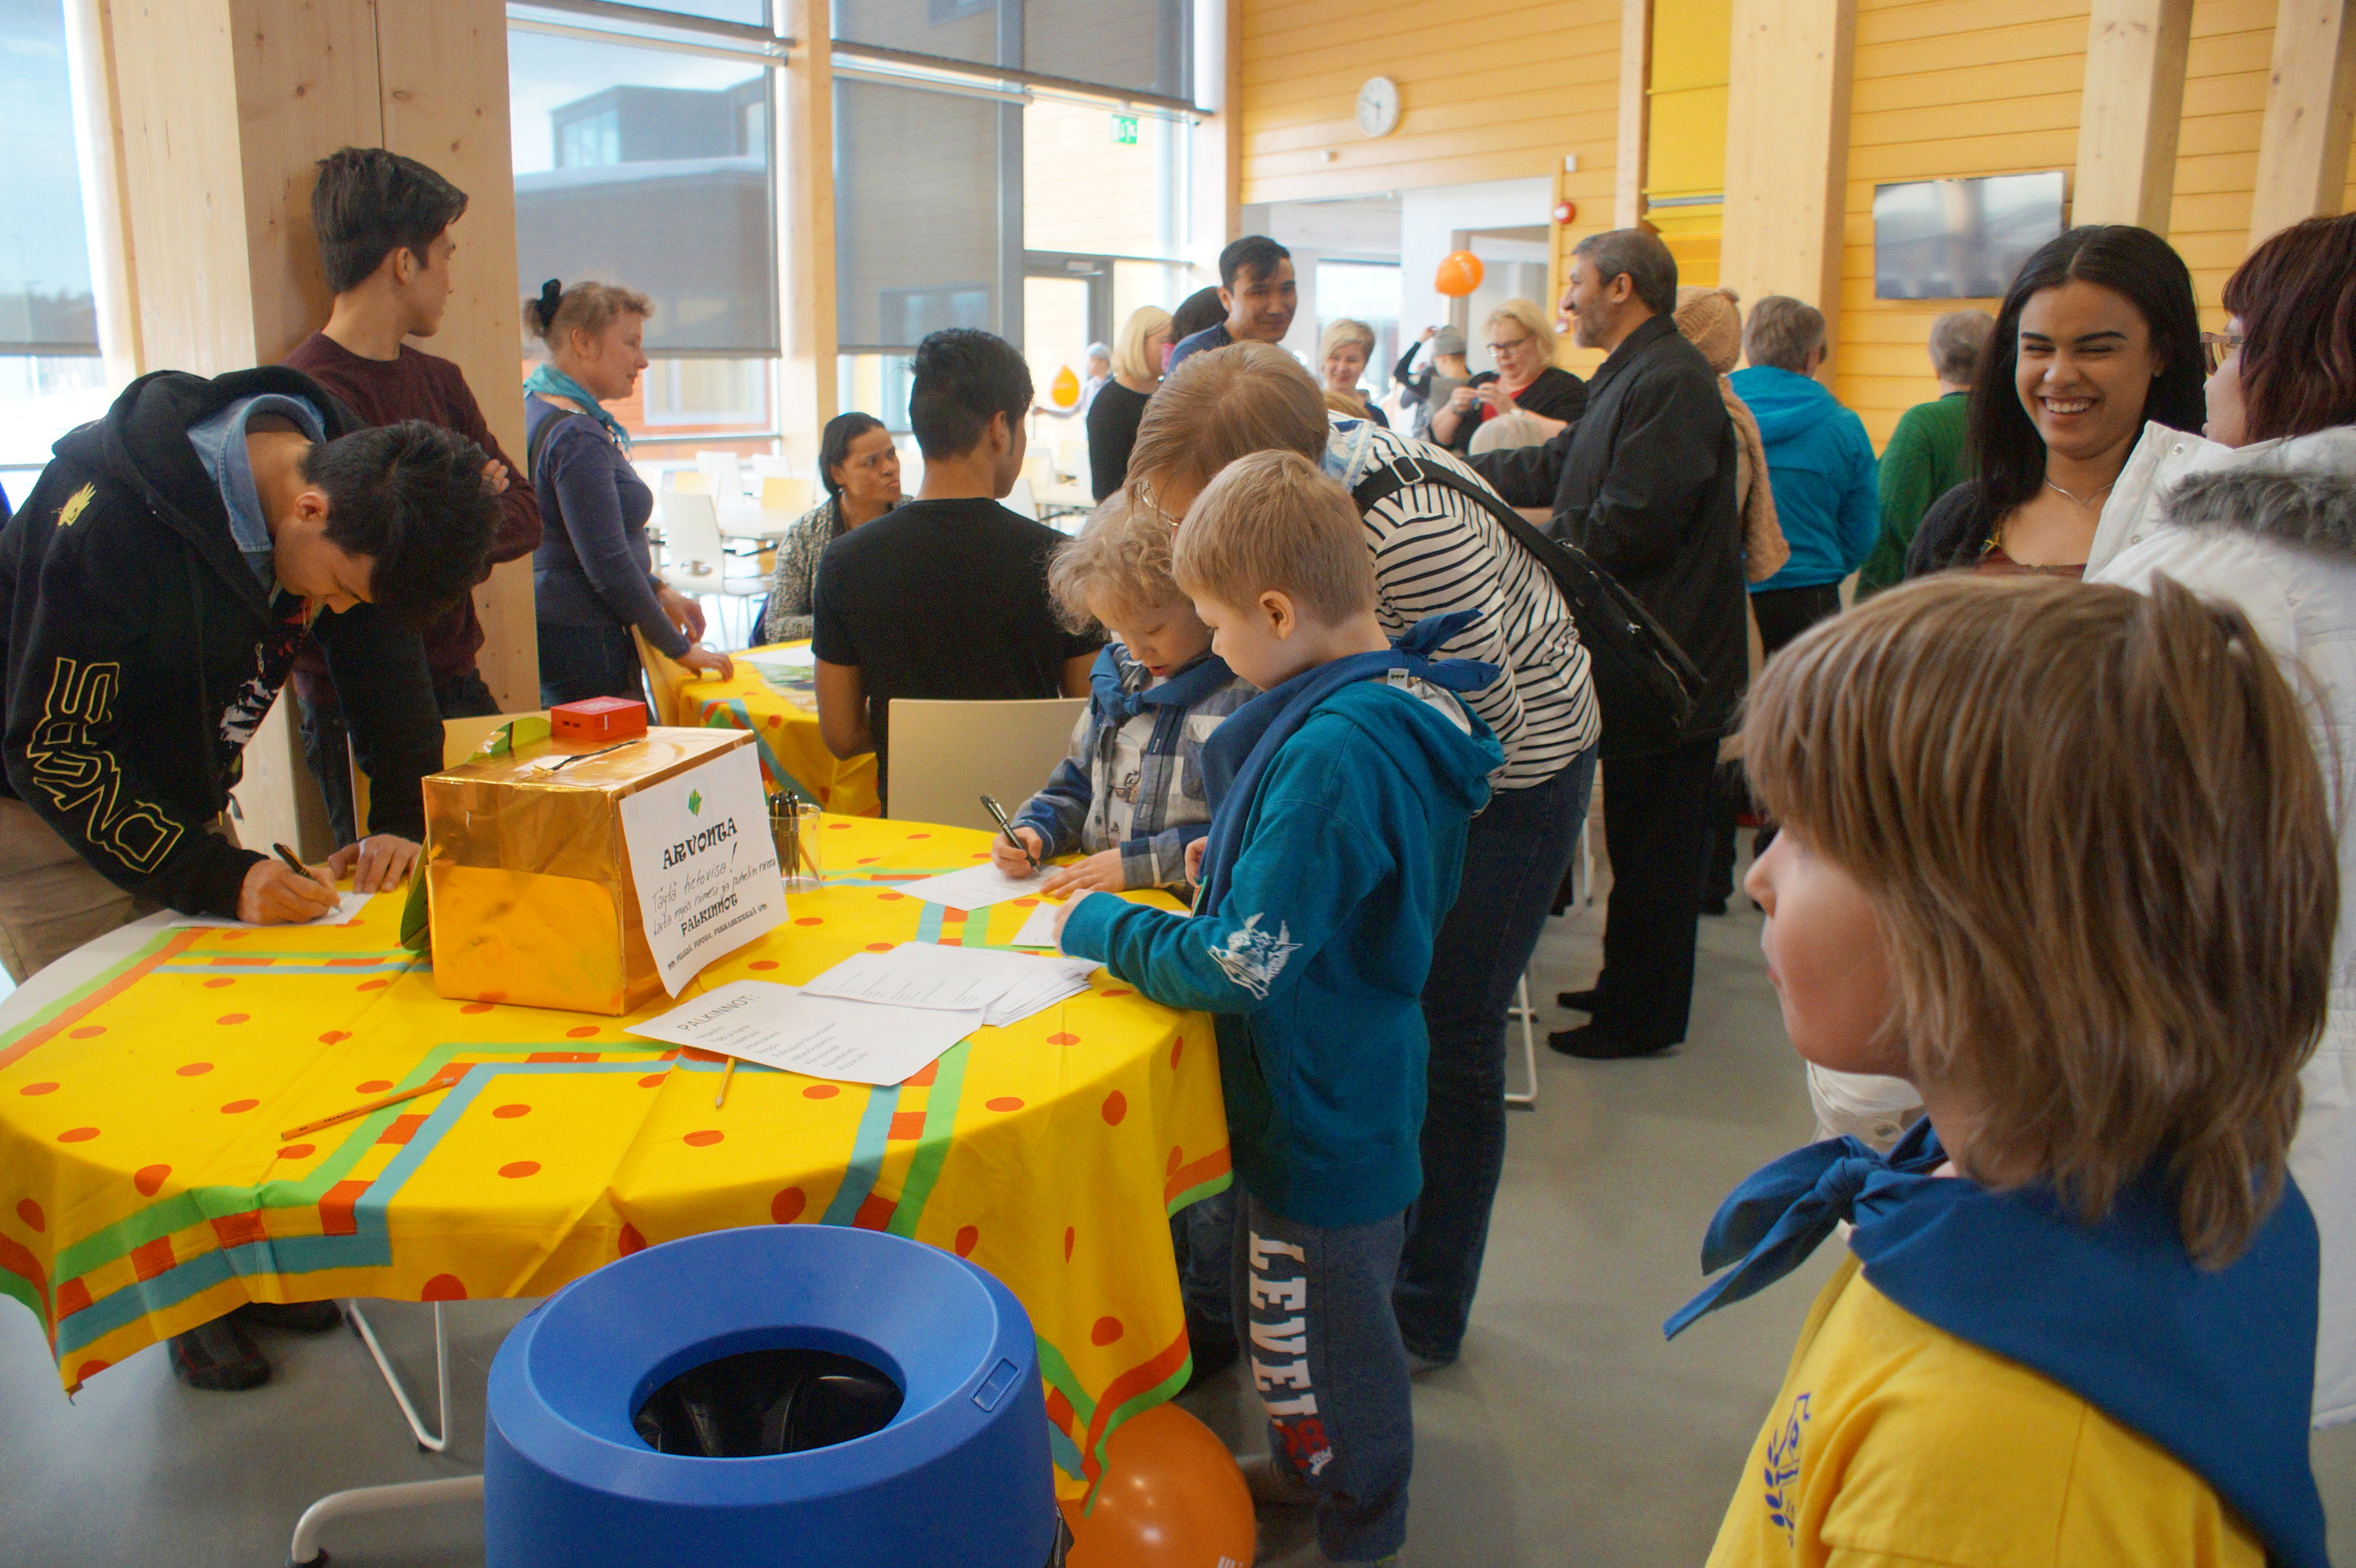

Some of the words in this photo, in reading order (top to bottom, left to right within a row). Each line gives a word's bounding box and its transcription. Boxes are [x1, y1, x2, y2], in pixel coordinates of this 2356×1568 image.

[661, 816, 738, 871] ARVONTA
[719, 881, 730, 900] ja
[680, 893, 738, 938] PALKINNOT
[677, 994, 761, 1031] PALKINNOT:
[1249, 1230, 1319, 1428] LEVEL
